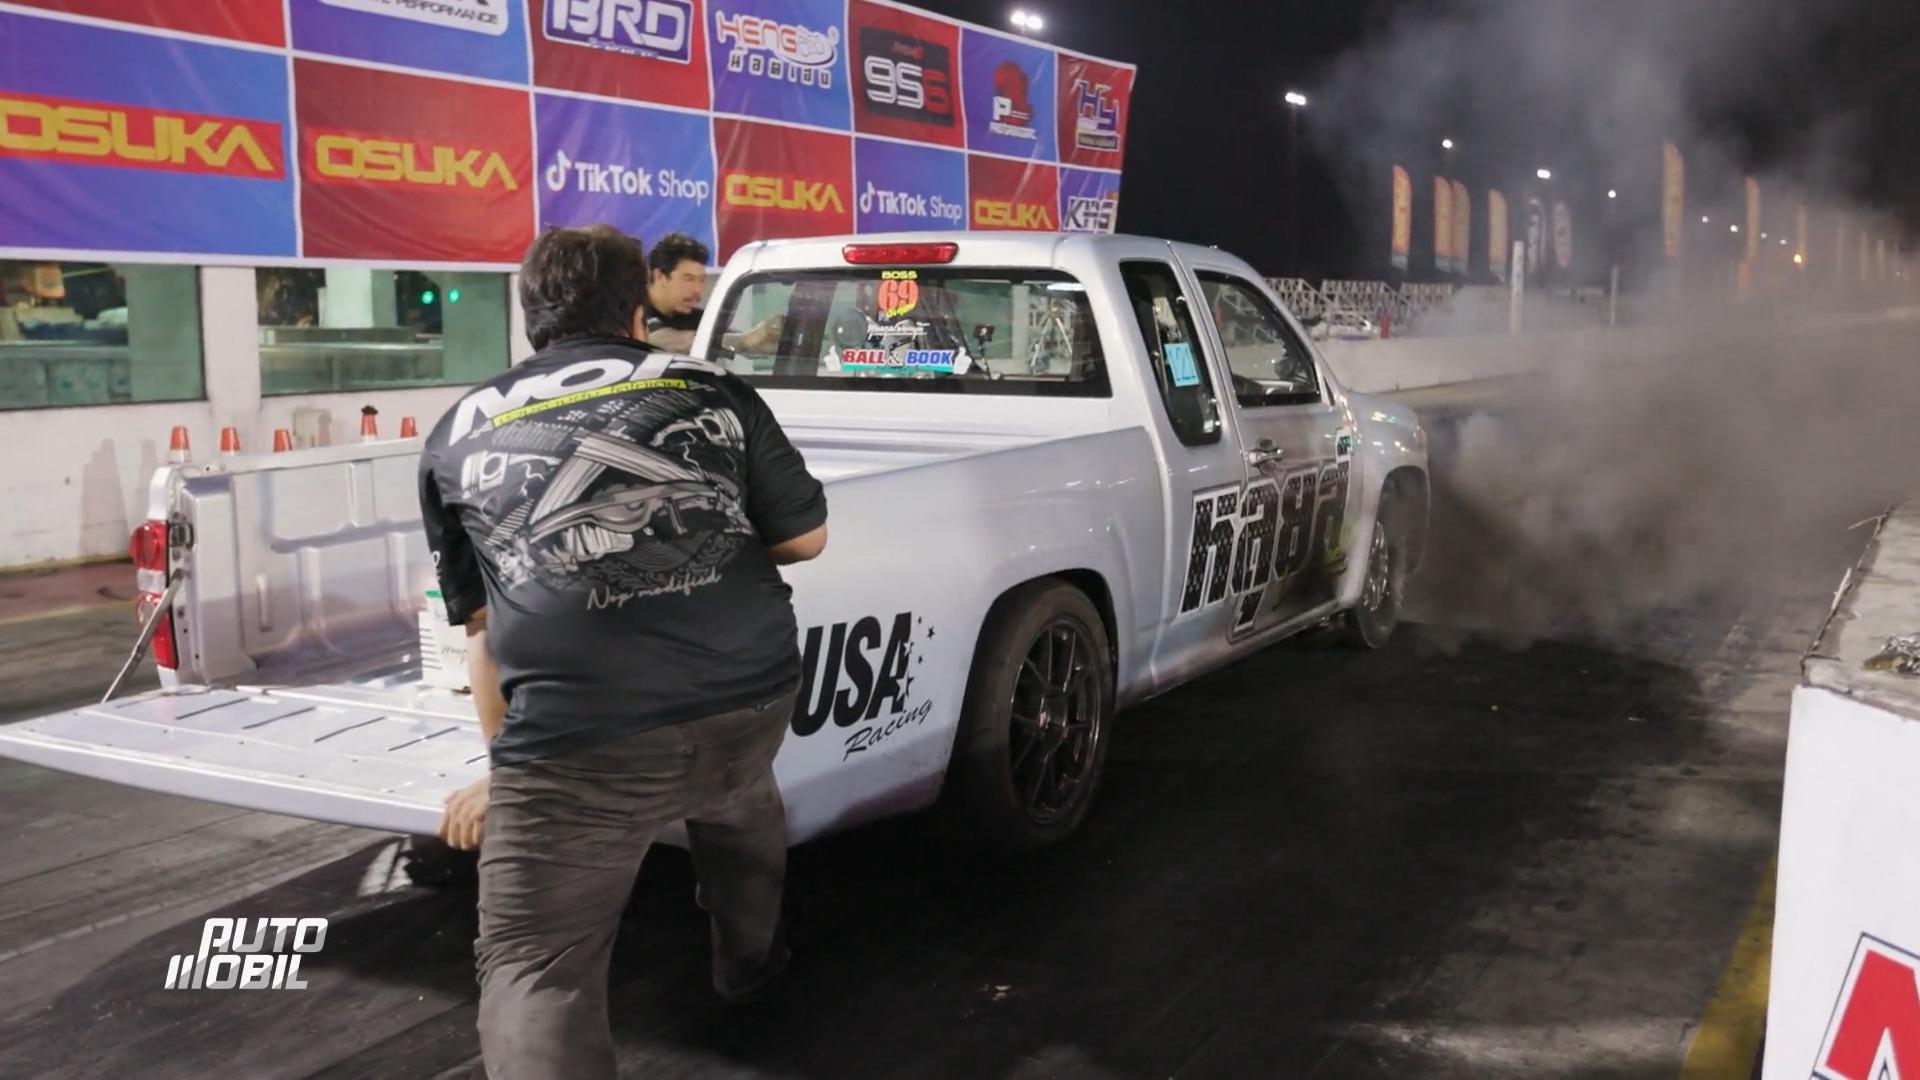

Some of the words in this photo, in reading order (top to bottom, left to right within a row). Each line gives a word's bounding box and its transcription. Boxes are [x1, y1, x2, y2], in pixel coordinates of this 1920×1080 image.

[552, 0, 686, 52] BRD
[0, 99, 275, 172] OSUKA
[315, 134, 518, 190] OSUKA
[574, 161, 653, 196] TikTok
[658, 169, 709, 206] Shop
[725, 173, 845, 214] OSUKA
[877, 190, 927, 217] TikTok
[930, 195, 963, 226] Shop
[974, 199, 1054, 230] OSUKA
[879, 280, 919, 311] 69
[882, 270, 918, 280] BOSS
[842, 350, 885, 364] BALL
[906, 351, 952, 365] BOOK
[638, 565, 722, 596] modified
[790, 611, 913, 737] USA
[842, 698, 933, 763] Racing
